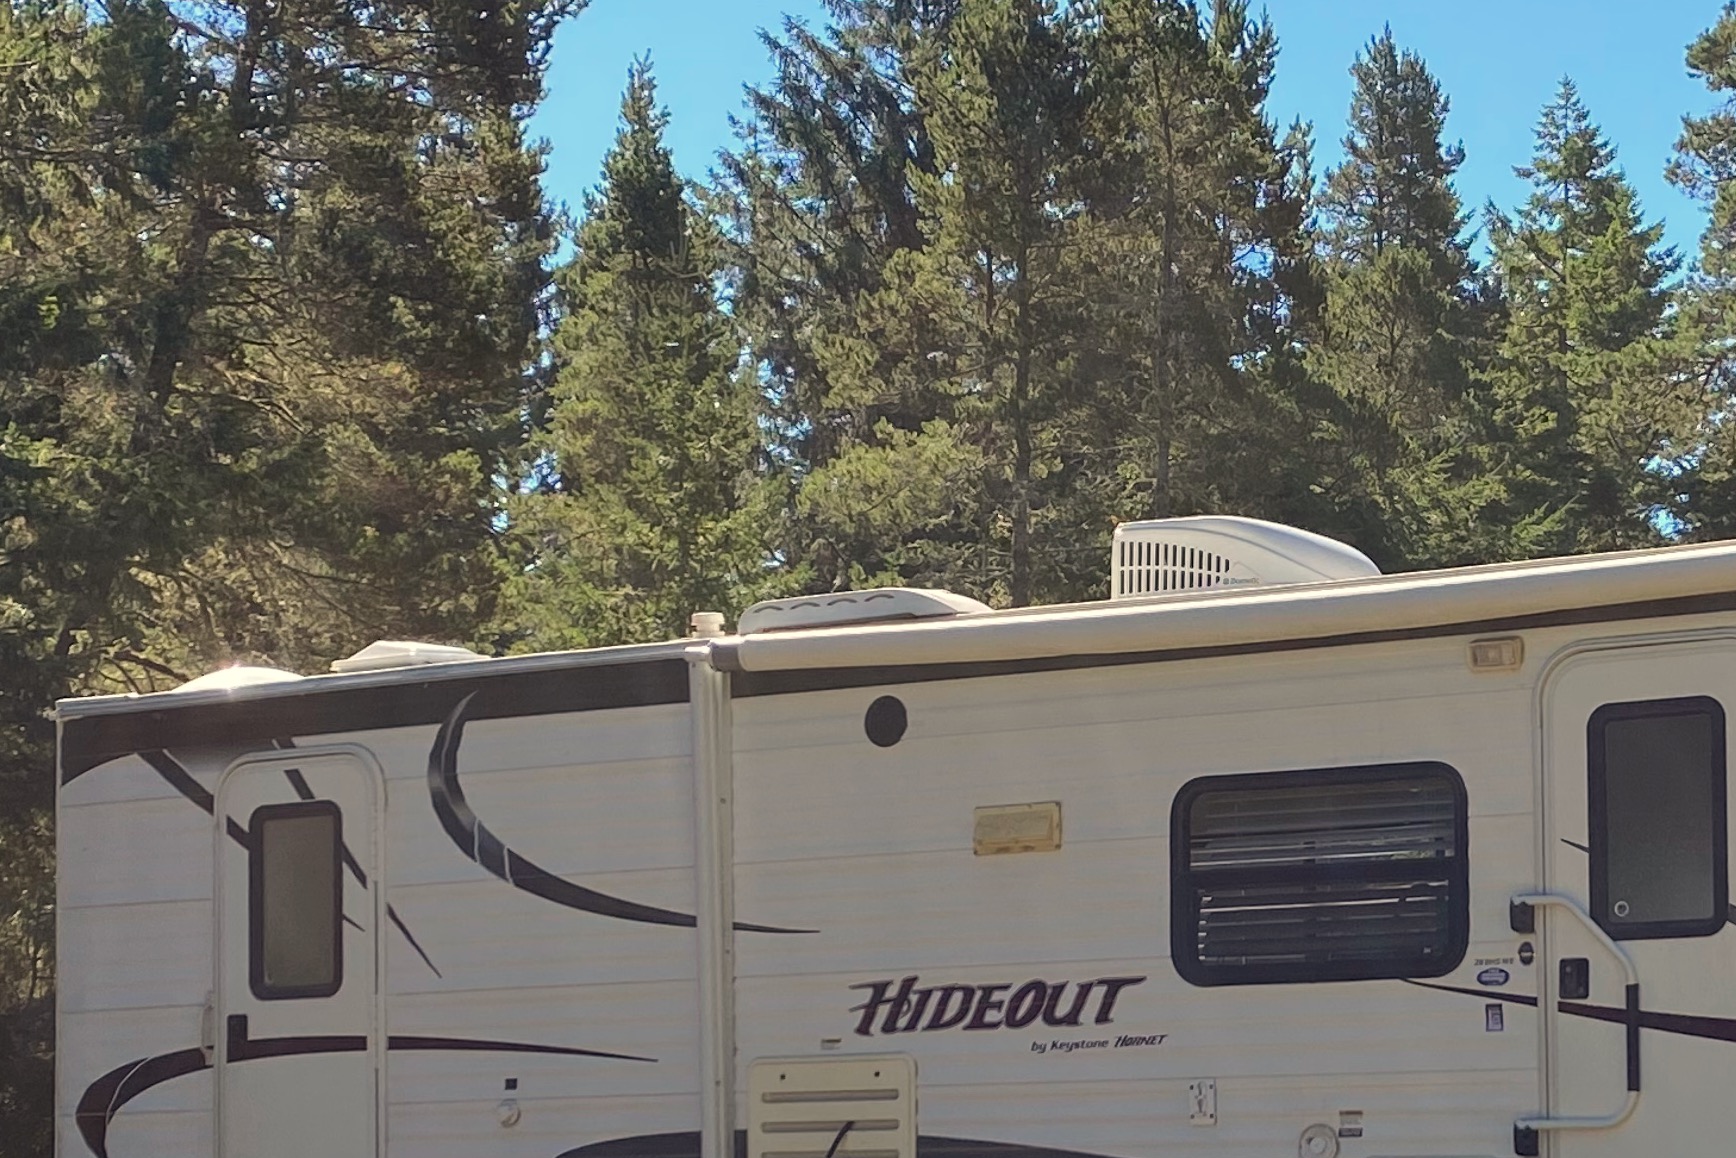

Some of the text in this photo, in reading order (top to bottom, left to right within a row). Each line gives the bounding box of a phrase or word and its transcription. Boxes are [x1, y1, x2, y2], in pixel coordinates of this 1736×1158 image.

[849, 975, 1147, 1036] HIDEOUT
[1031, 1034, 1168, 1054] by Keystone HORNET
